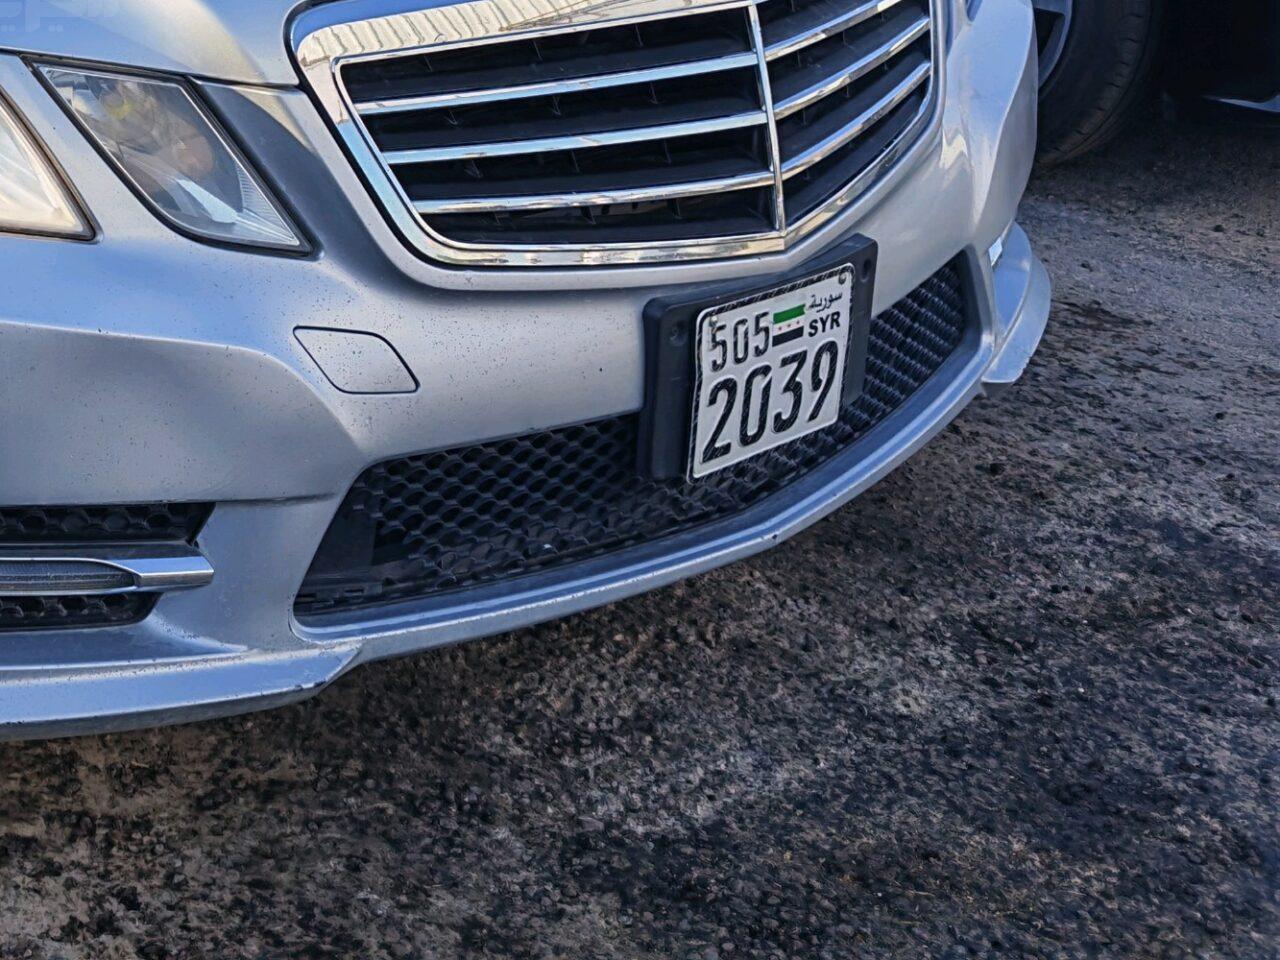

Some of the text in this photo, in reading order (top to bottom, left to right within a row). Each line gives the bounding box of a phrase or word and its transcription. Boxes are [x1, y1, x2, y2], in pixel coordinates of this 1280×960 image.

[709, 311, 770, 372] 505
[808, 310, 841, 337] SYR
[701, 340, 839, 464] 2039
